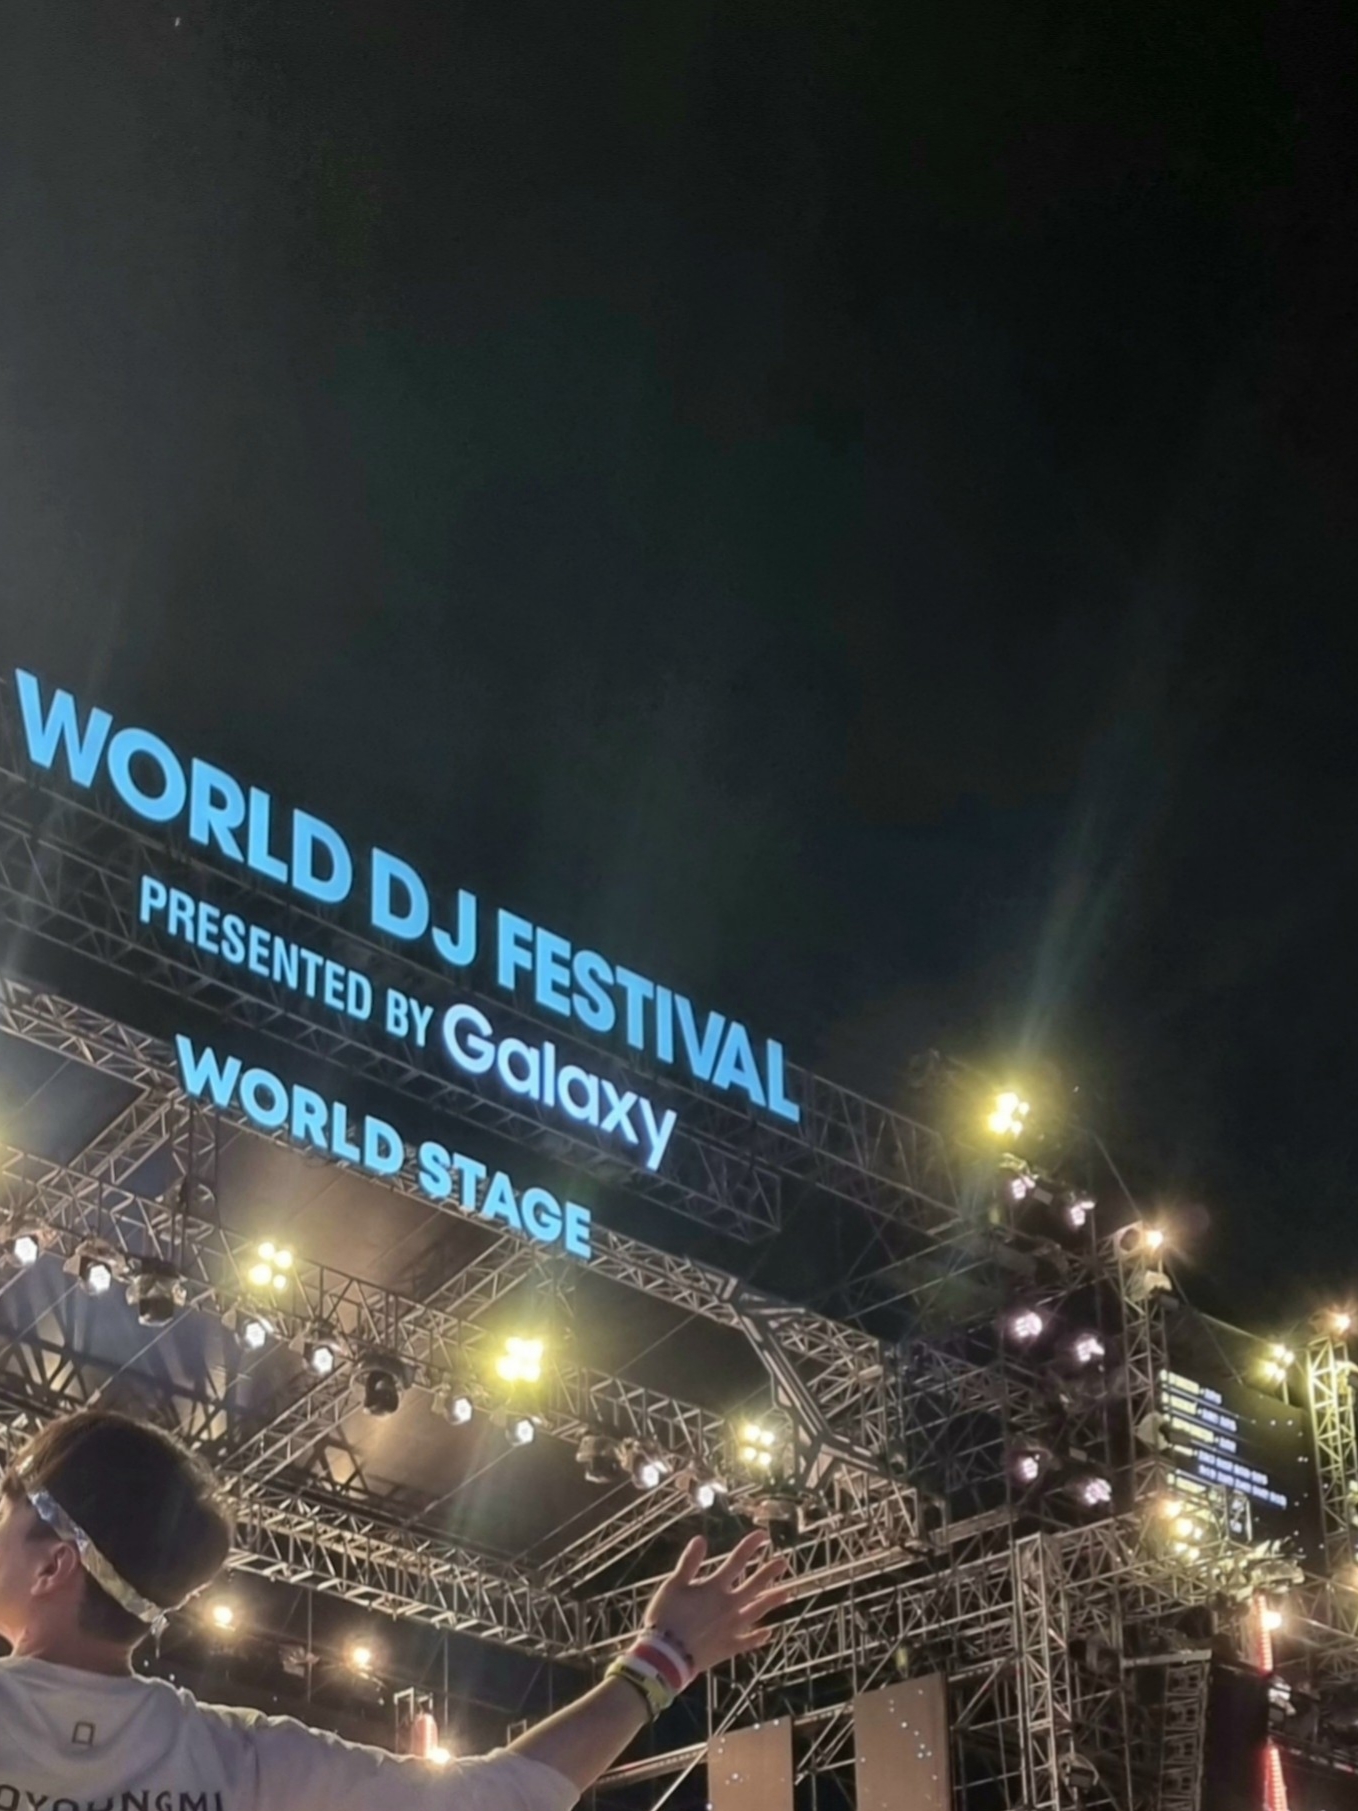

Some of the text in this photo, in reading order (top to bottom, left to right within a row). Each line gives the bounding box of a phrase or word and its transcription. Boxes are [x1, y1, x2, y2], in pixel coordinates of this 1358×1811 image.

[16, 668, 800, 1123] WORLD DJ FESTIVAL
[140, 875, 677, 1171] PRESENTED BY Galaxy
[176, 1034, 592, 1259] WORLD STAGE
